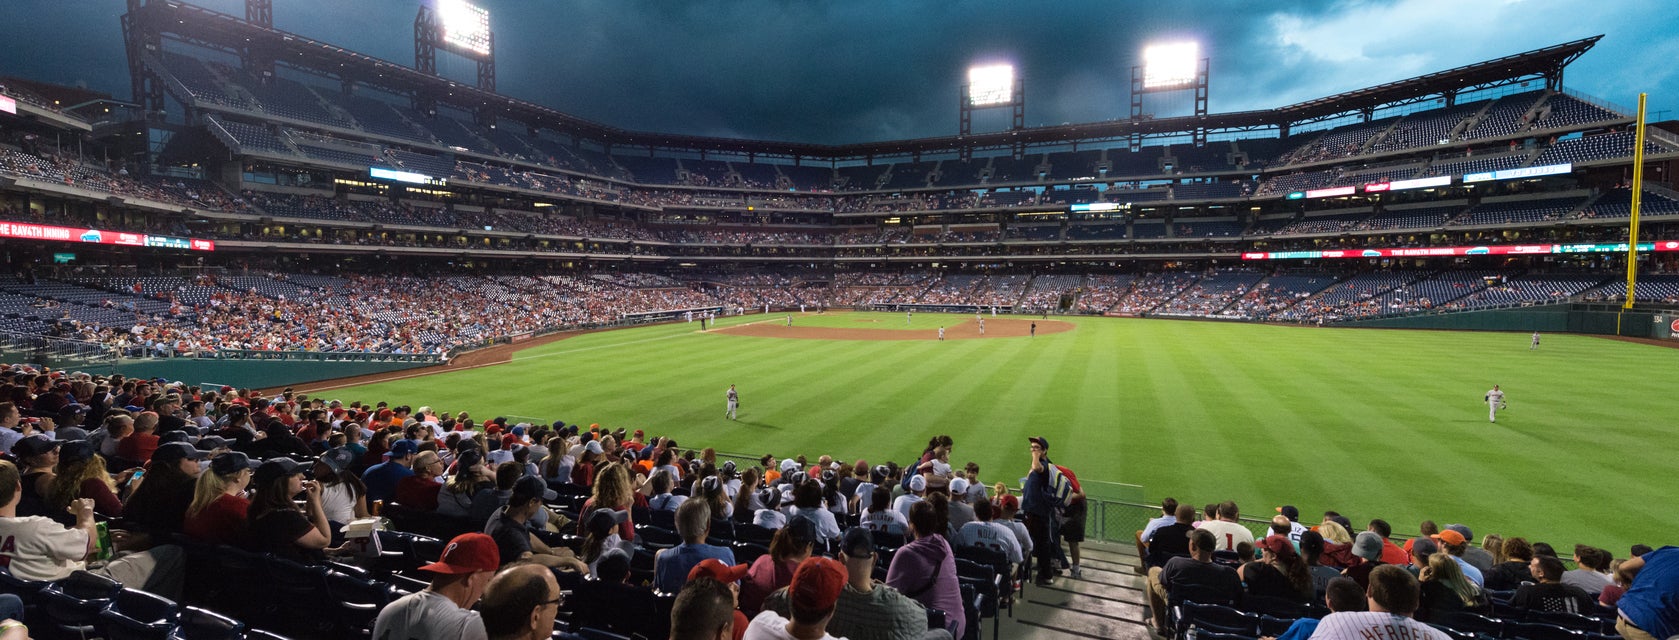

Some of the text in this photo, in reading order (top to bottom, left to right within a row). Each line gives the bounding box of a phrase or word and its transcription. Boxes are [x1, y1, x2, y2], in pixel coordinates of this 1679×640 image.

[43, 227, 70, 239] INNING
[977, 528, 998, 541] NOLA
[1225, 533, 1234, 551] 1
[444, 542, 458, 558] P
